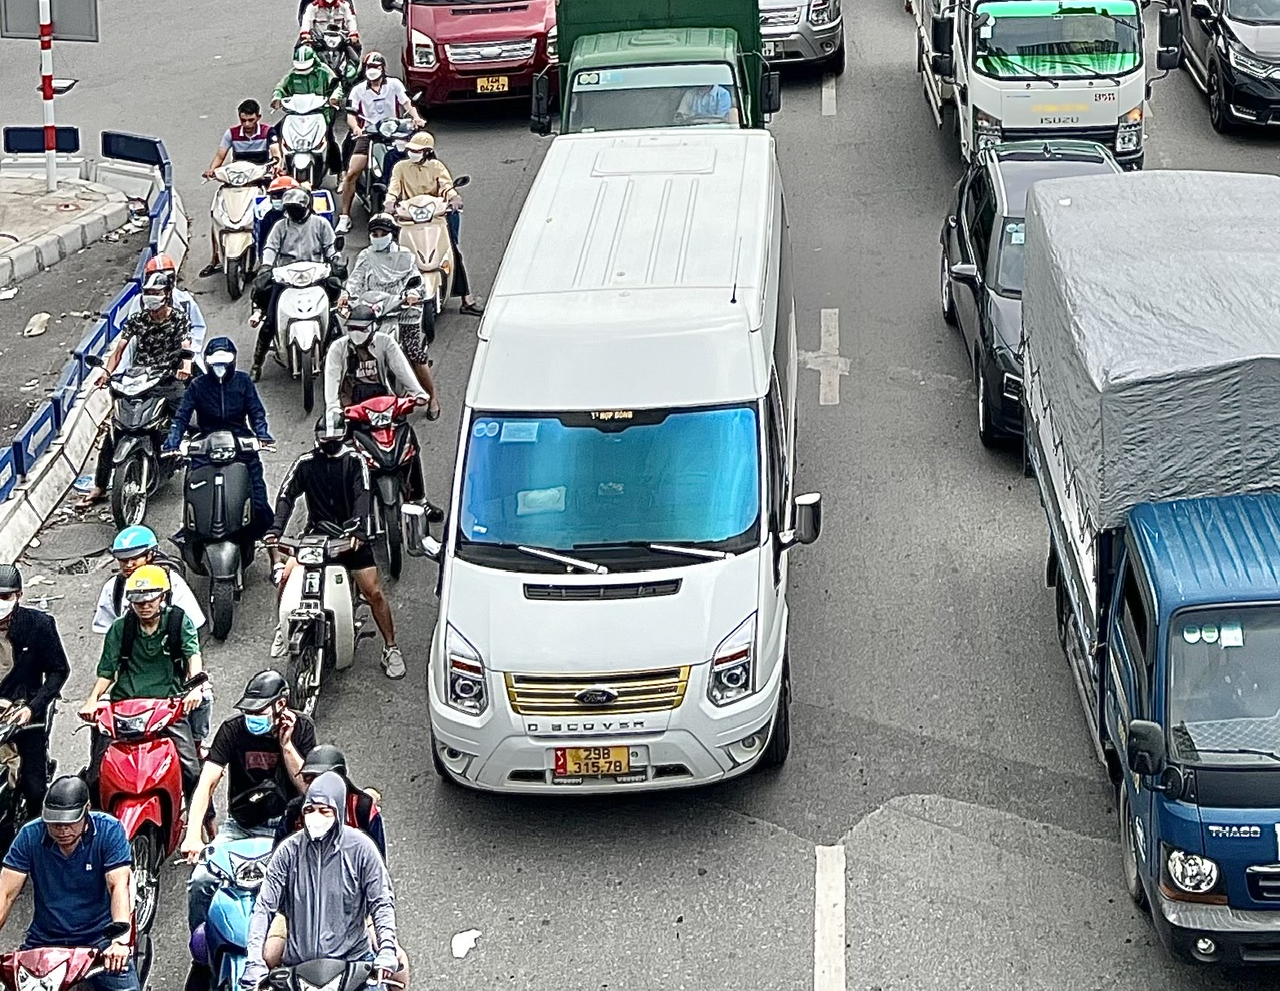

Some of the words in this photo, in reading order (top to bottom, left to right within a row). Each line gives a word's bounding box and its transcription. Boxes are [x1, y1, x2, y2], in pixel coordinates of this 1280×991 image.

[1040, 116, 1080, 125] ISUZU
[583, 747, 611, 761] 29B
[573, 760, 623, 774] 315.78
